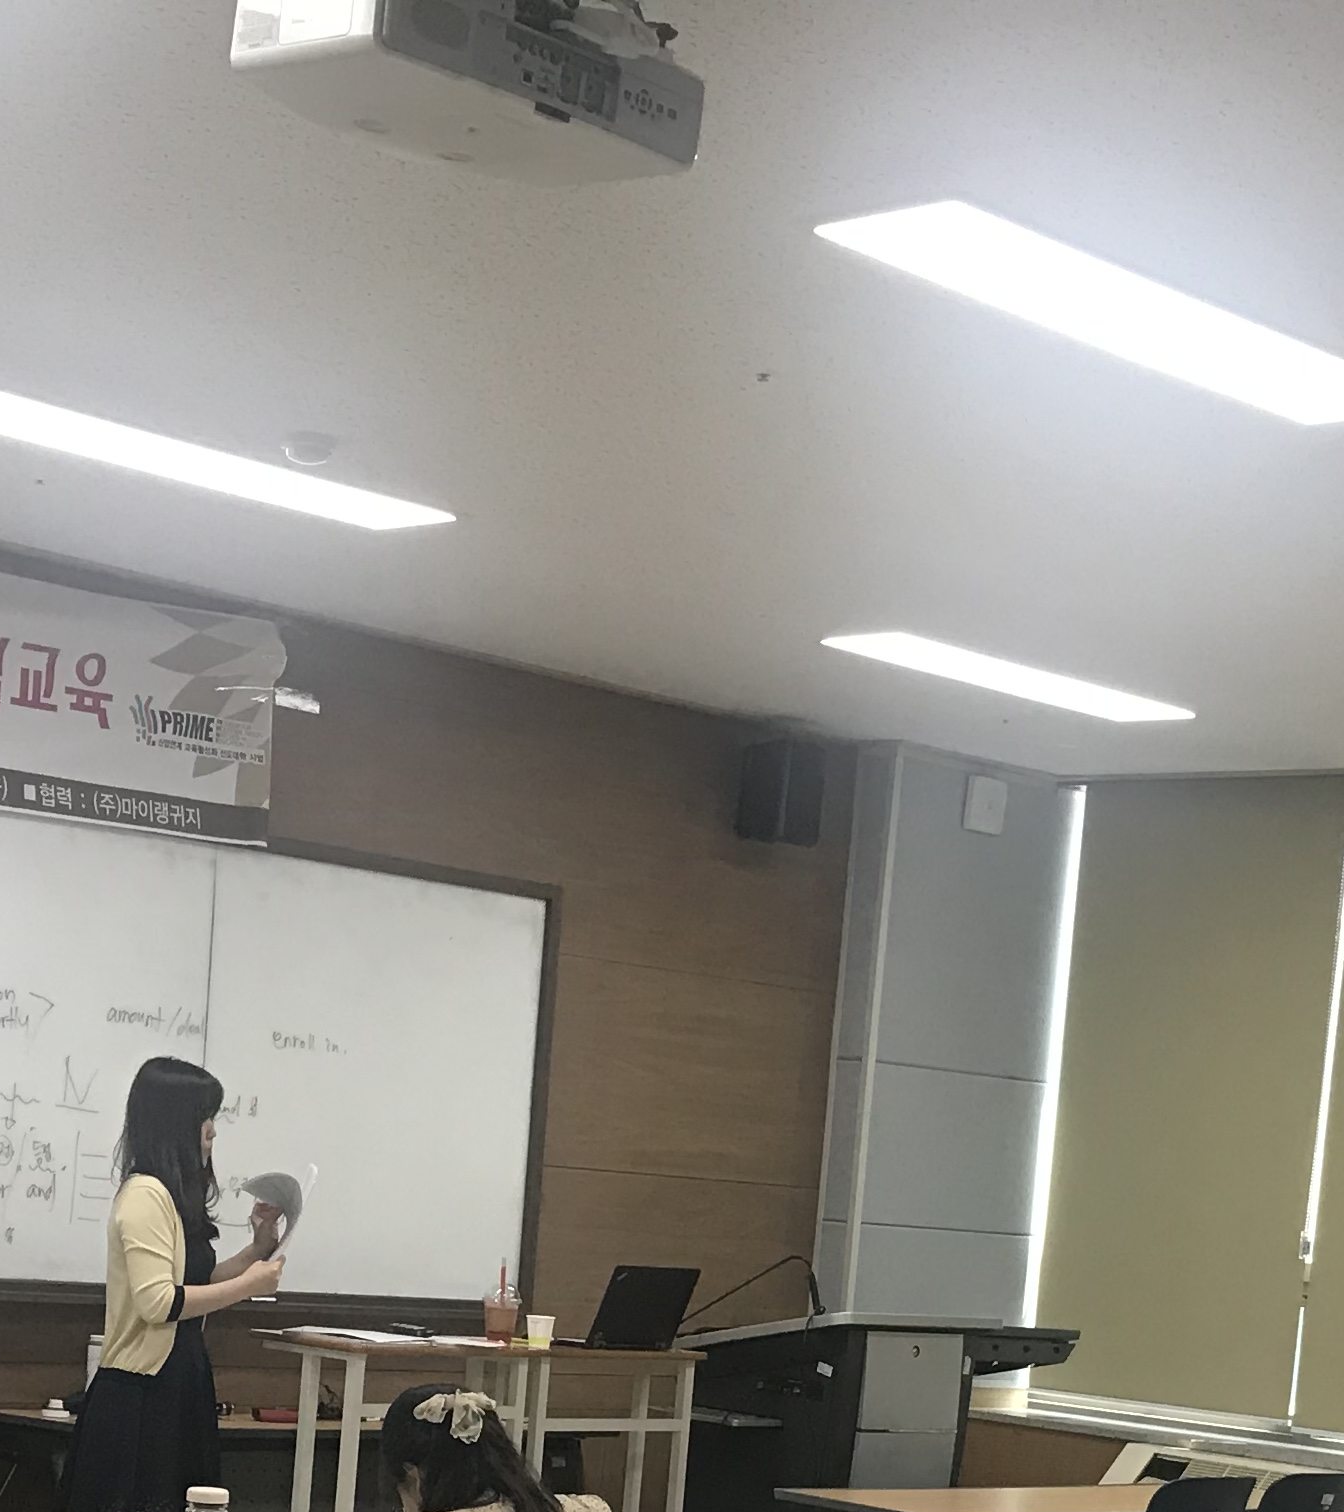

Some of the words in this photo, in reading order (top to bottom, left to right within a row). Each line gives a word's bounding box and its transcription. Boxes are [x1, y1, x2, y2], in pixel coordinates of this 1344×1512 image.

[158, 710, 217, 743] PRIME
[39, 783, 73, 811] 협력
[92, 789, 202, 831] (주)마이랭귀지
[272, 1029, 316, 1053] enroll
[64, 1056, 100, 1105] N
